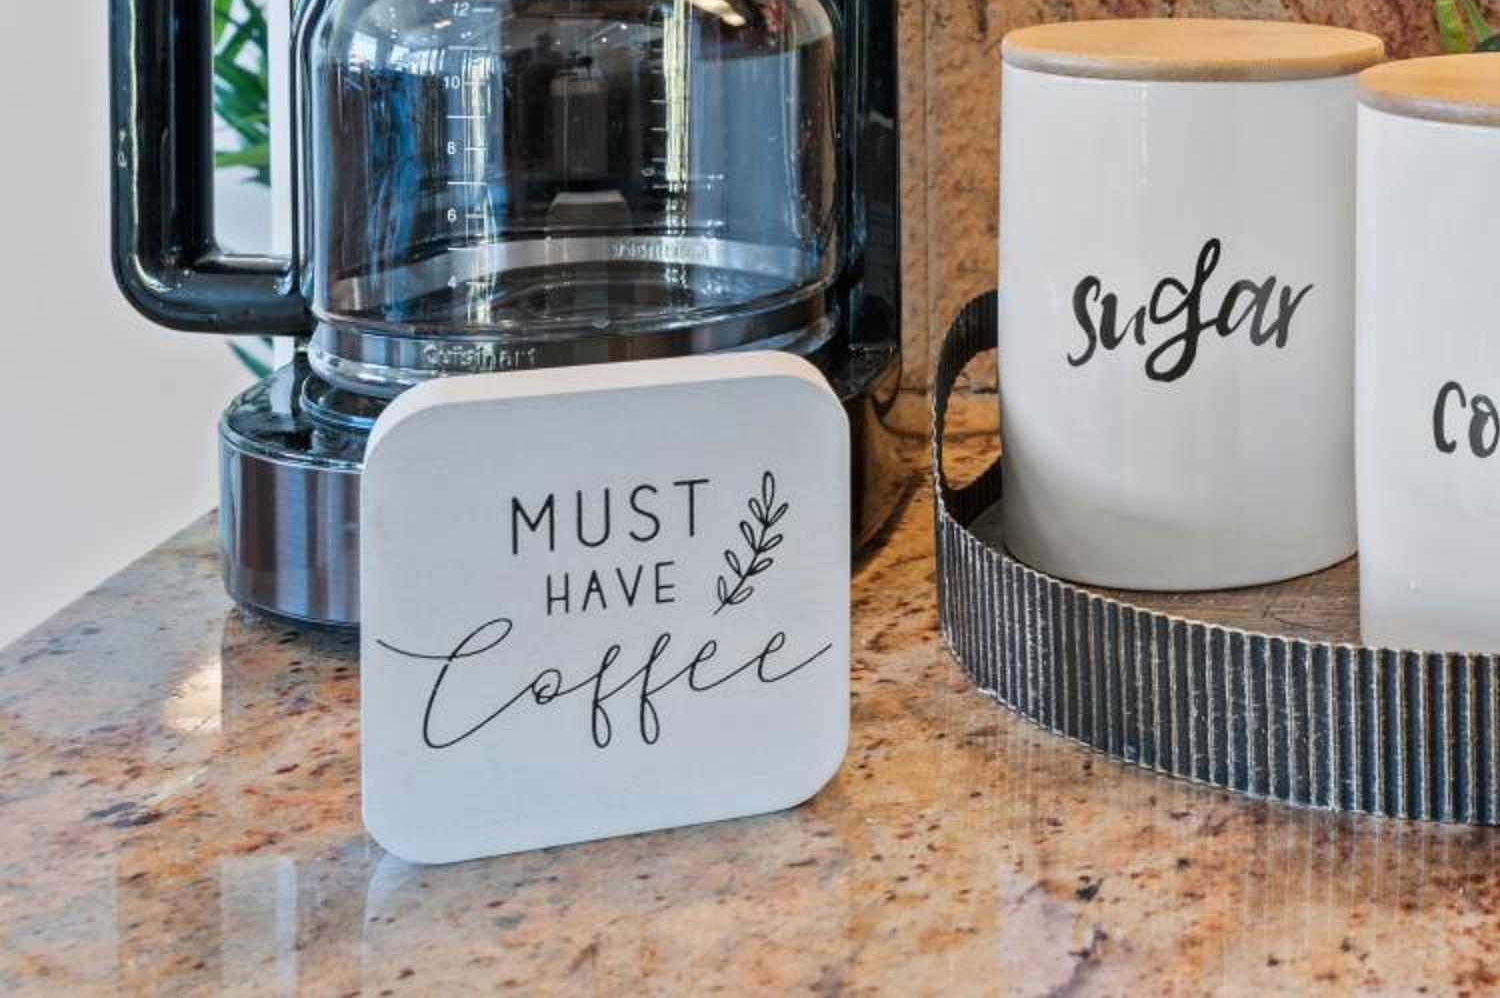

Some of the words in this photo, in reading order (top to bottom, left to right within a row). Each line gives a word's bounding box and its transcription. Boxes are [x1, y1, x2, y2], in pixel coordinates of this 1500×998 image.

[452, 1, 471, 17] 12
[443, 74, 461, 90] 10
[446, 140, 457, 155] 8
[446, 207, 457, 223] 6
[1067, 237, 1314, 382] sugar
[512, 479, 709, 555] MUST
[546, 561, 676, 616] HAVE
[376, 617, 833, 749] Coffee
